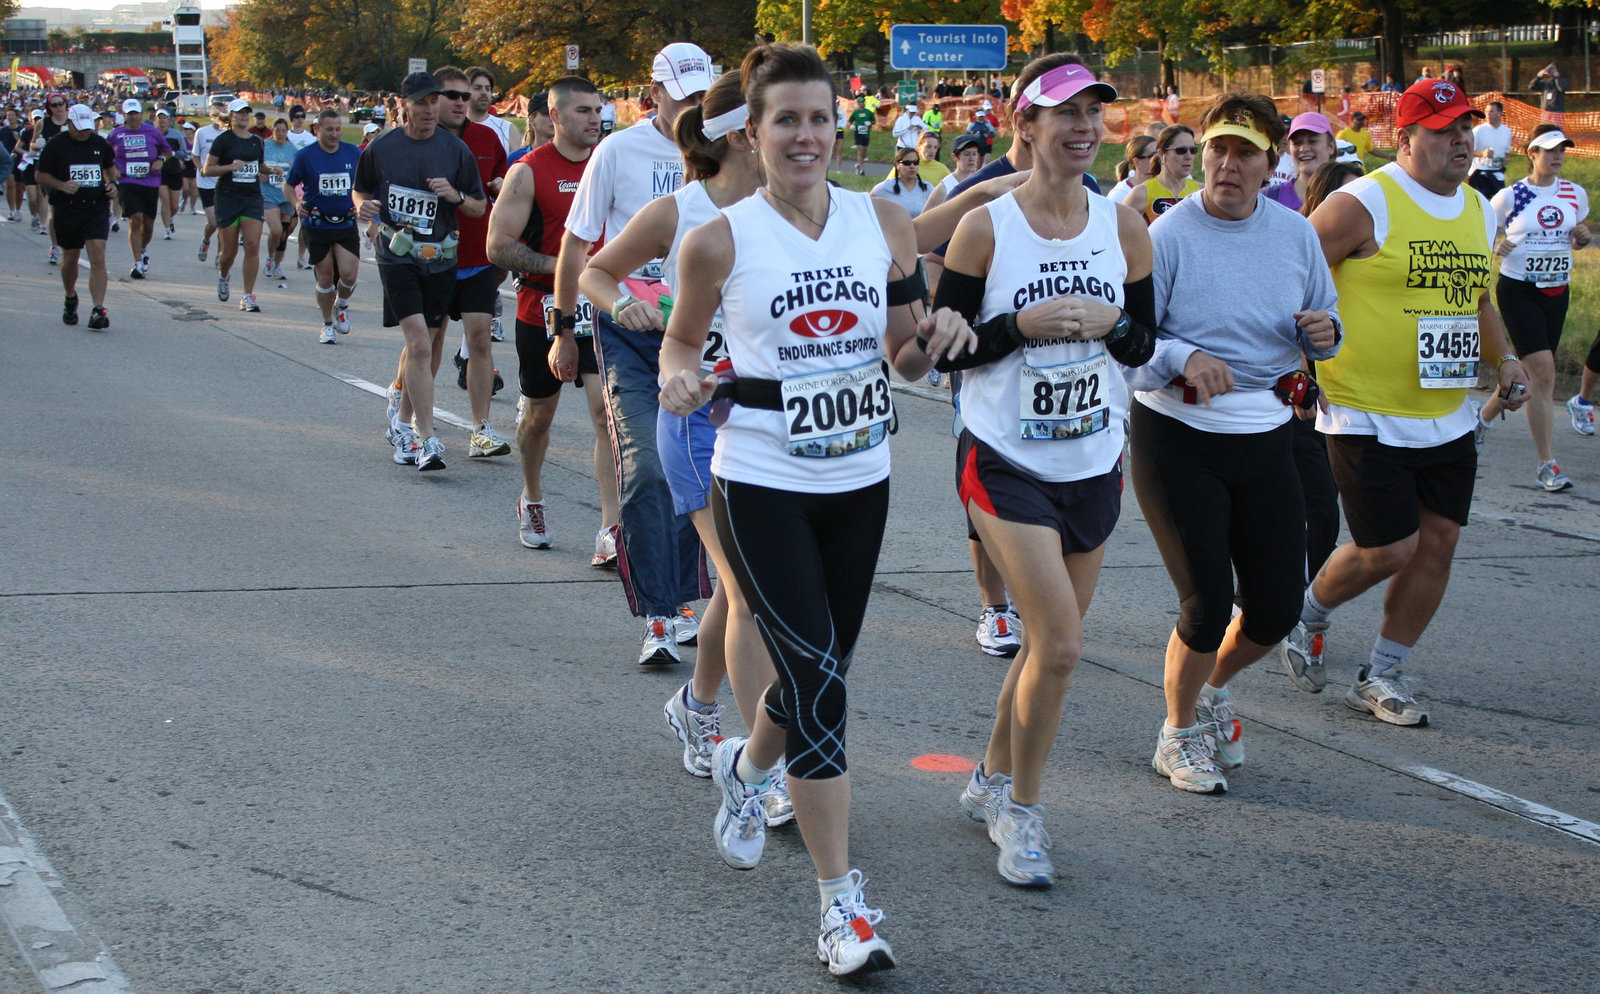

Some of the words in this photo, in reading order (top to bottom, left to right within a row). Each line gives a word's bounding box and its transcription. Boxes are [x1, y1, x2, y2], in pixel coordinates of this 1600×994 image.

[918, 33, 966, 44] Tourist
[972, 33, 999, 44] Info
[918, 52, 964, 62] Center
[653, 161, 663, 170] IN
[71, 169, 101, 180] 25613
[322, 178, 347, 189] 5111
[388, 193, 437, 218] 31818
[1409, 240, 1459, 256] TEAM
[1039, 260, 1089, 273] BETTY
[1409, 254, 1490, 271] RUNNING
[1525, 257, 1569, 272] 32725
[791, 265, 854, 283] TRIXIE
[770, 280, 880, 319] CHICAGO
[1013, 275, 1116, 311] CHICAGO
[778, 340, 843, 361] ENDURANCE
[844, 337, 878, 354] SPORTS
[1419, 331, 1480, 359] 34552
[783, 381, 821, 394] MARINE
[820, 375, 850, 389] CORPS
[1032, 373, 1102, 416] 8722
[786, 378, 891, 435] 20043
